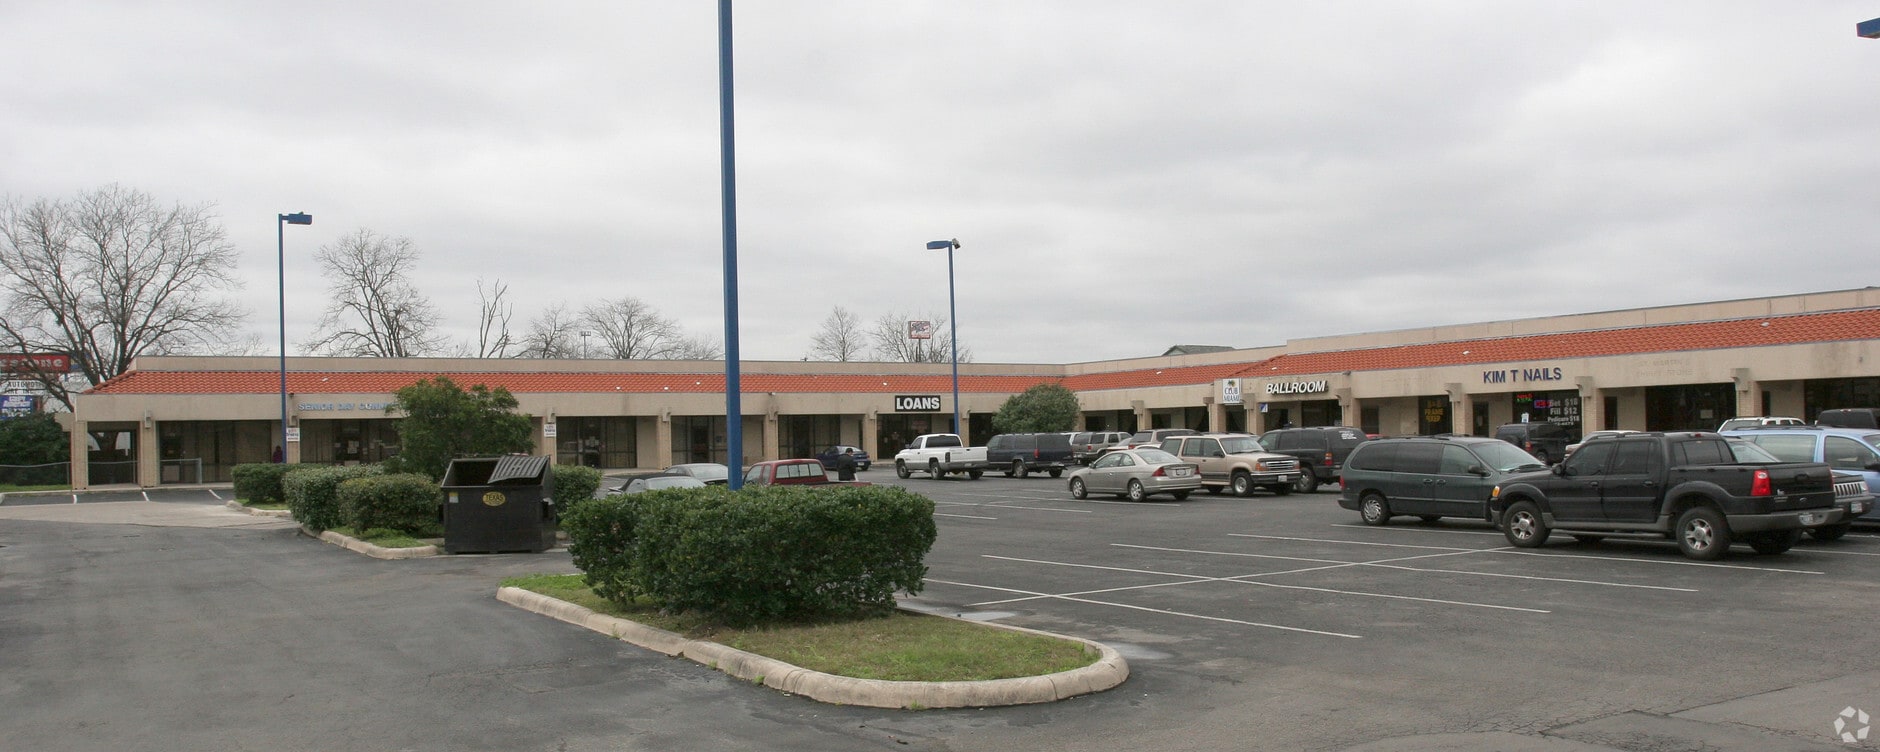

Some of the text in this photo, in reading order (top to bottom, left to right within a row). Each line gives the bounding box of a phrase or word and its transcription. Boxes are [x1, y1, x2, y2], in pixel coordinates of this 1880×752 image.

[1483, 367, 1562, 384] KIM T NAILS
[1266, 380, 1328, 394] BALLROOM
[896, 397, 940, 410] LOANS
